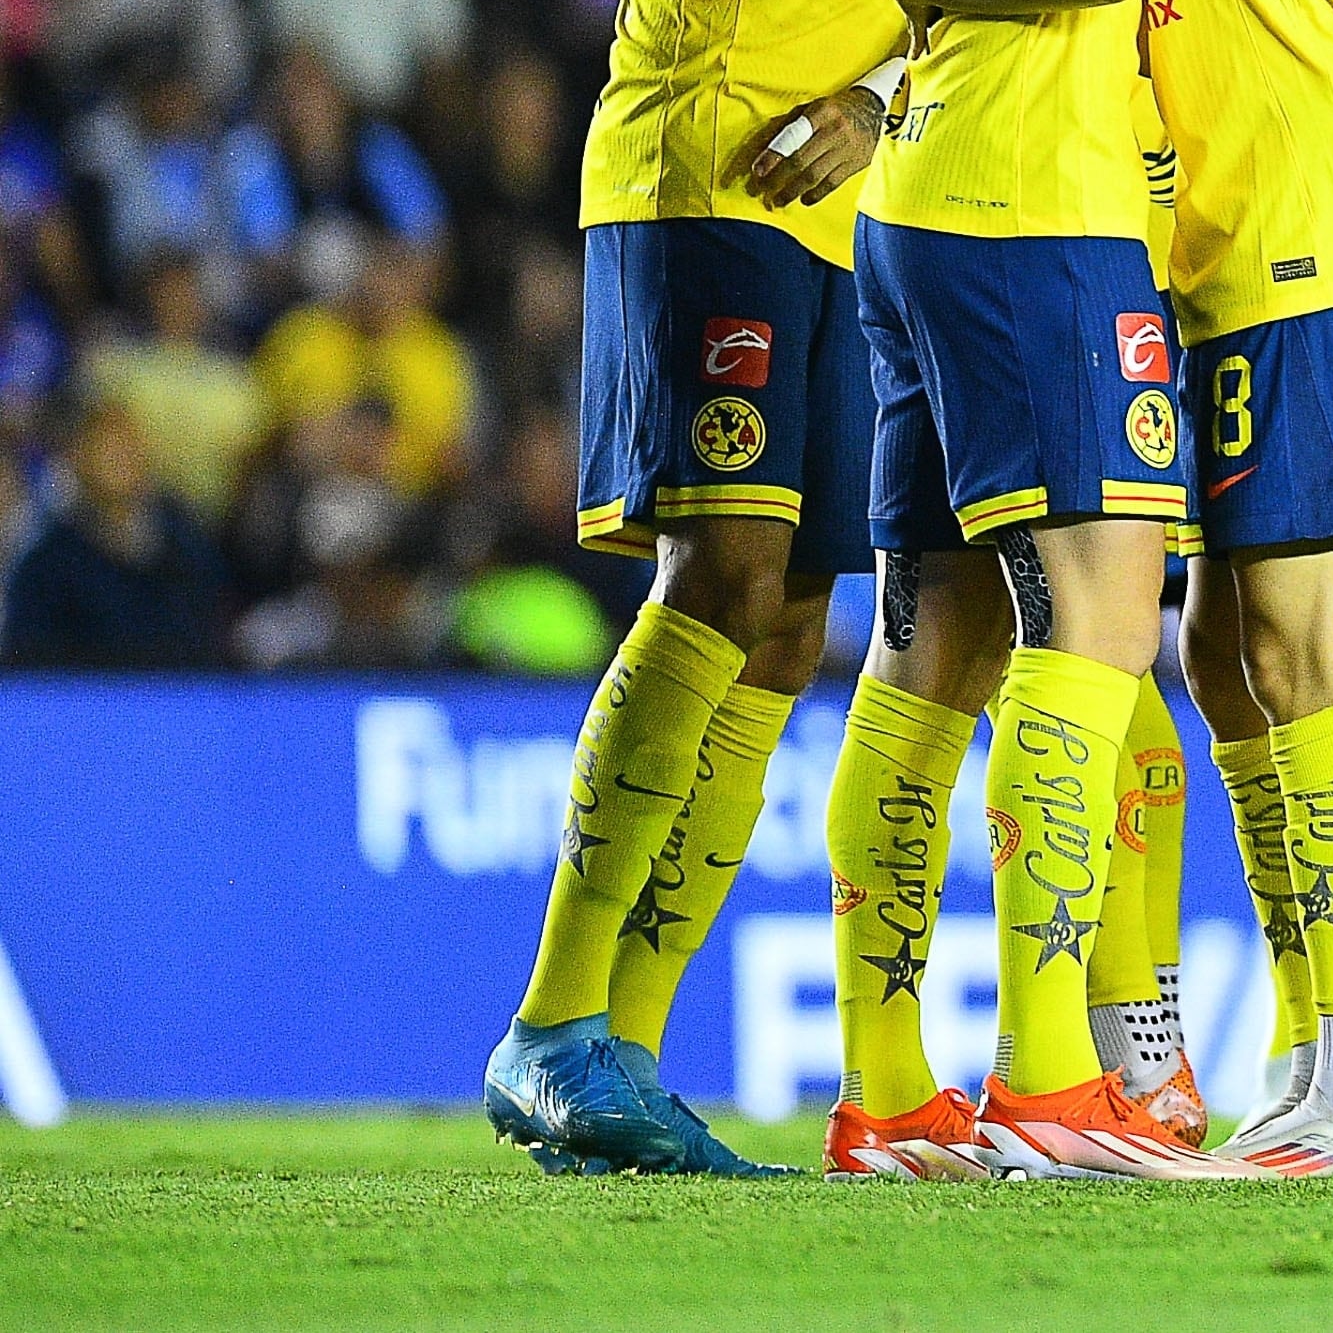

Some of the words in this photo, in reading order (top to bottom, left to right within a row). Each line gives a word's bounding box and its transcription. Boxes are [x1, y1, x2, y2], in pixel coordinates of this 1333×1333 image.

[1212, 354, 1252, 457] 8
[868, 835, 929, 941] Carl's
[1010, 772, 1095, 900] Carl's
